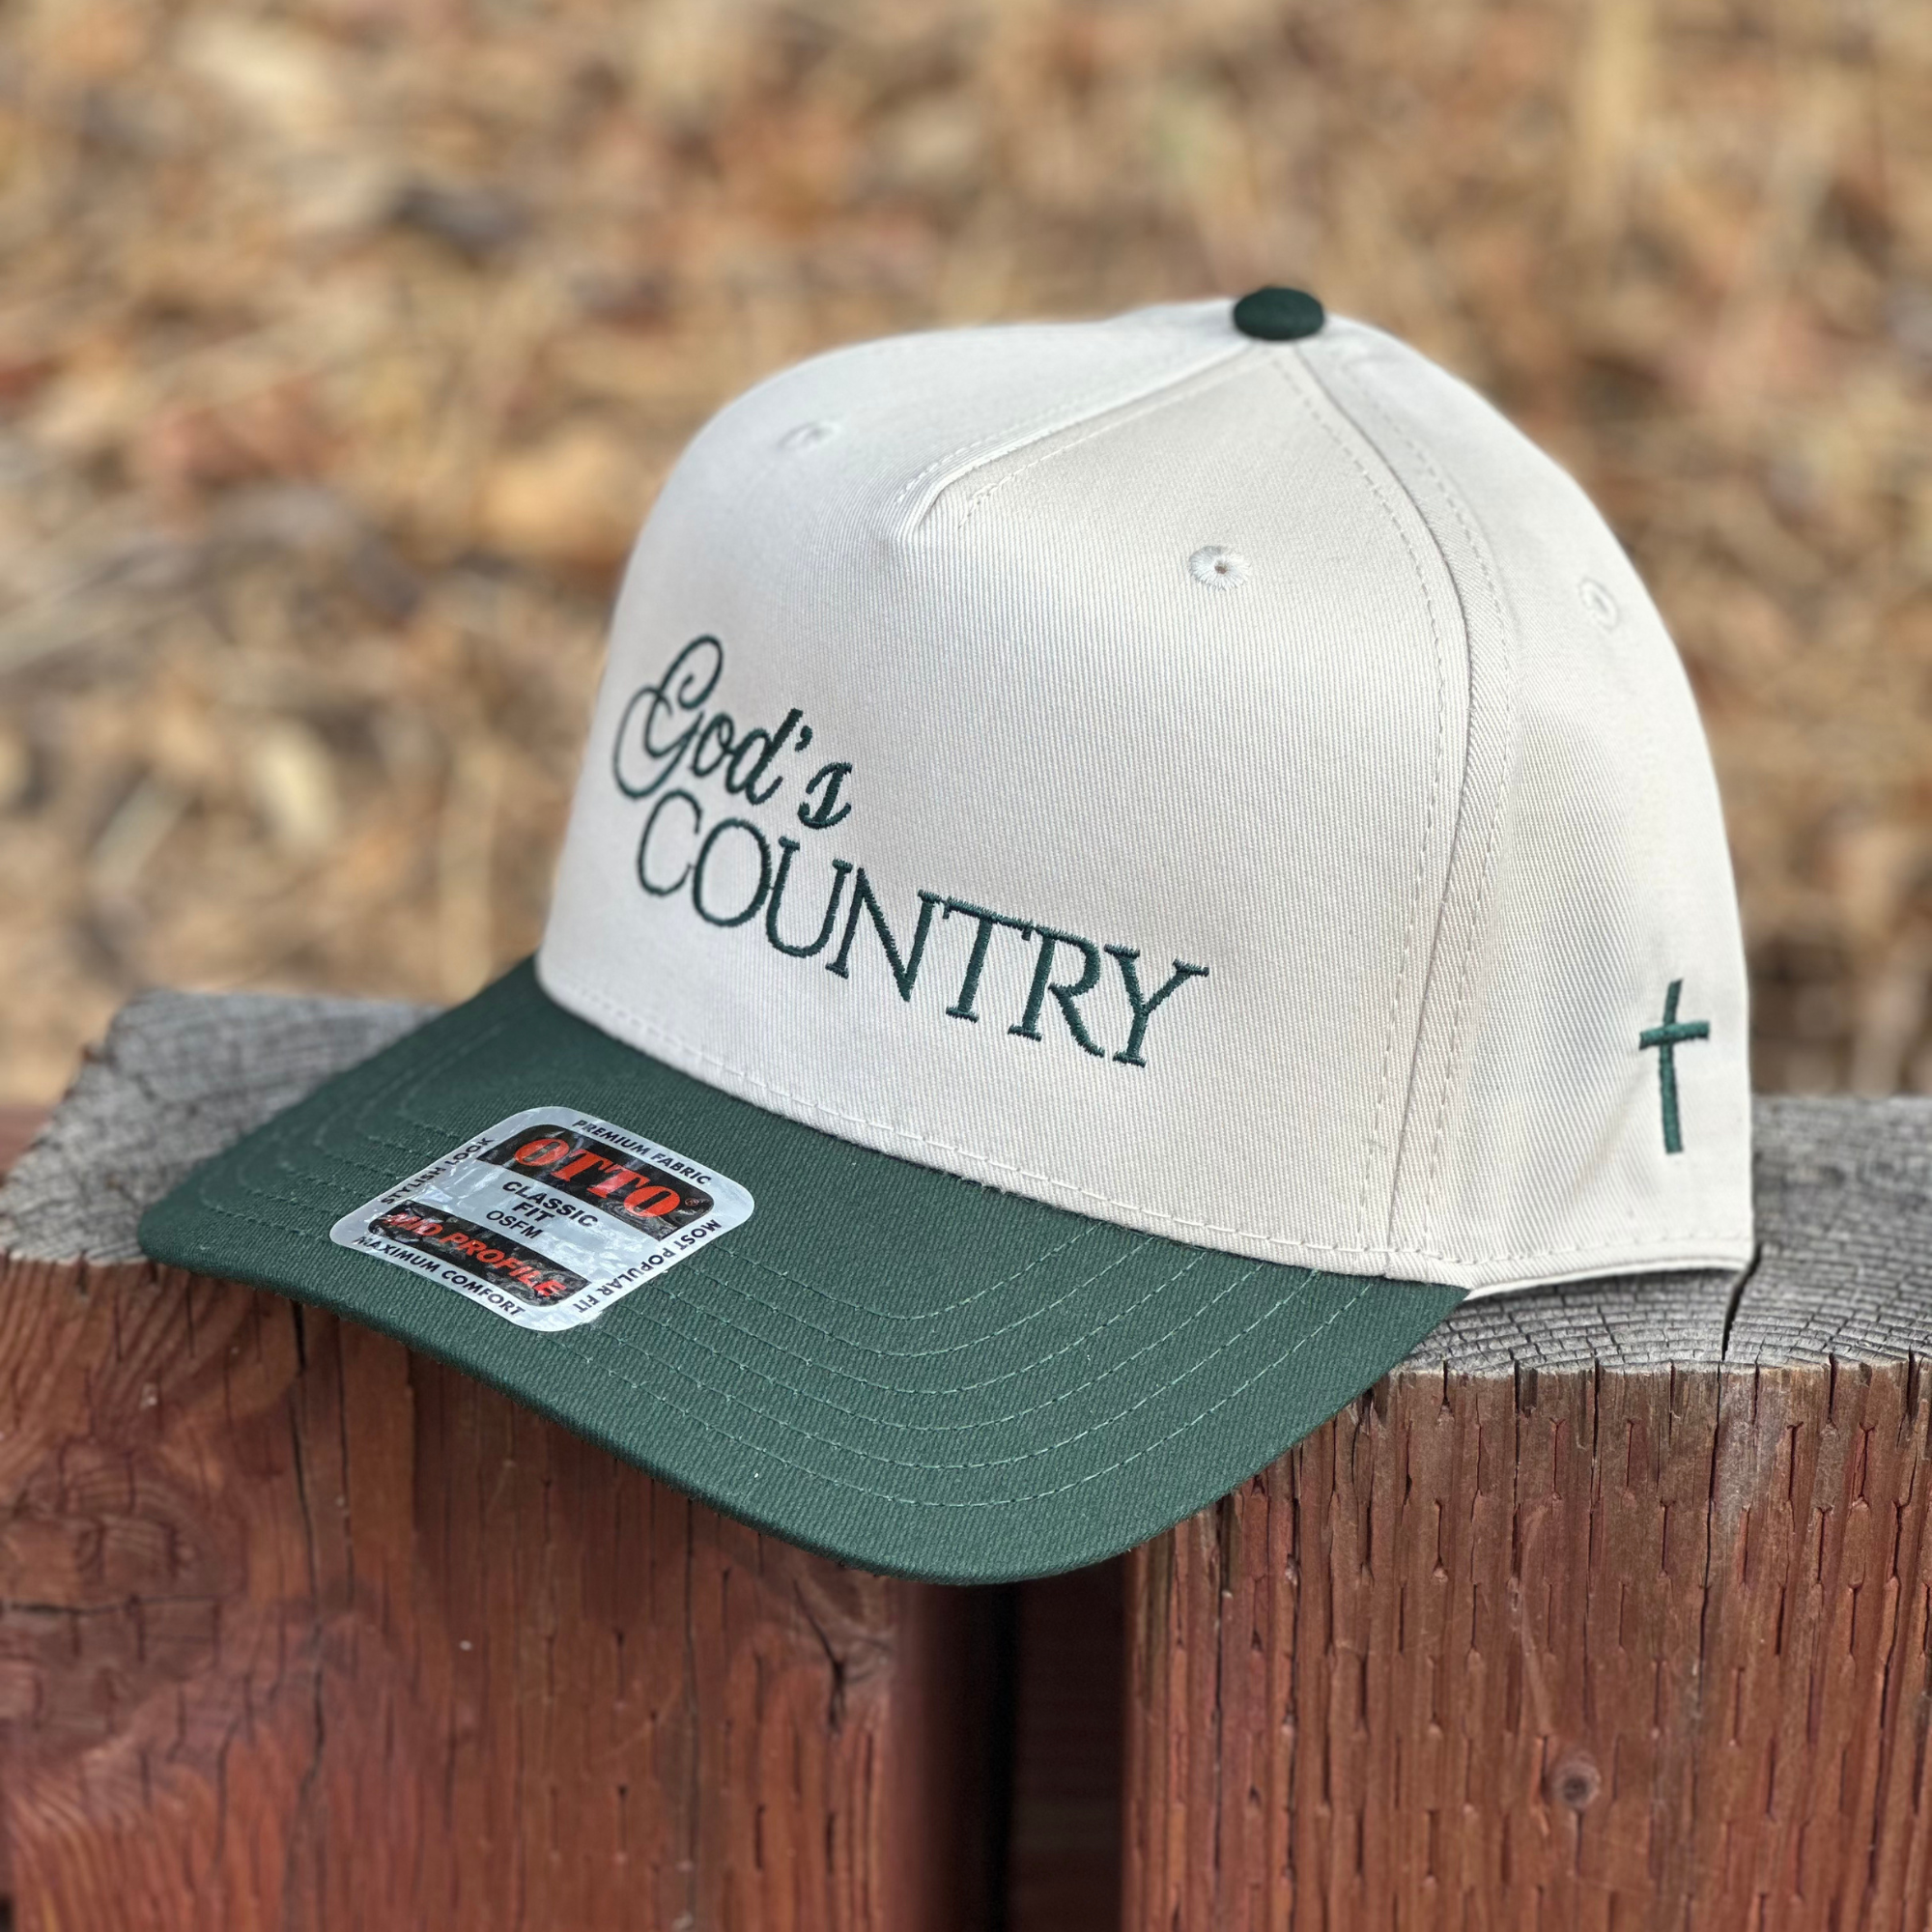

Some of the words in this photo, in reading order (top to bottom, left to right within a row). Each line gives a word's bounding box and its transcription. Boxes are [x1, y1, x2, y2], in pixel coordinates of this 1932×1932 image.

[613, 634, 852, 830] God's
[637, 790, 1209, 1068] COUNTRY
[381, 1166, 447, 1205] STYLISH
[444, 1137, 497, 1166] LOOK
[513, 1137, 681, 1218] OTTO
[572, 1119, 651, 1156] PREMIUM
[649, 1151, 713, 1186] FABRIC
[486, 1209, 544, 1239] OSFM
[501, 1180, 598, 1228] CLASSIC
[512, 1201, 555, 1223] FIT
[673, 1219, 723, 1251] MOST
[352, 1236, 440, 1273] MAXIMUM
[440, 1269, 527, 1317] COMFORT
[384, 1211, 443, 1236] MID
[438, 1232, 567, 1297] PROFILE
[595, 1246, 676, 1296] POPULAR
[572, 1294, 601, 1314] FIT
